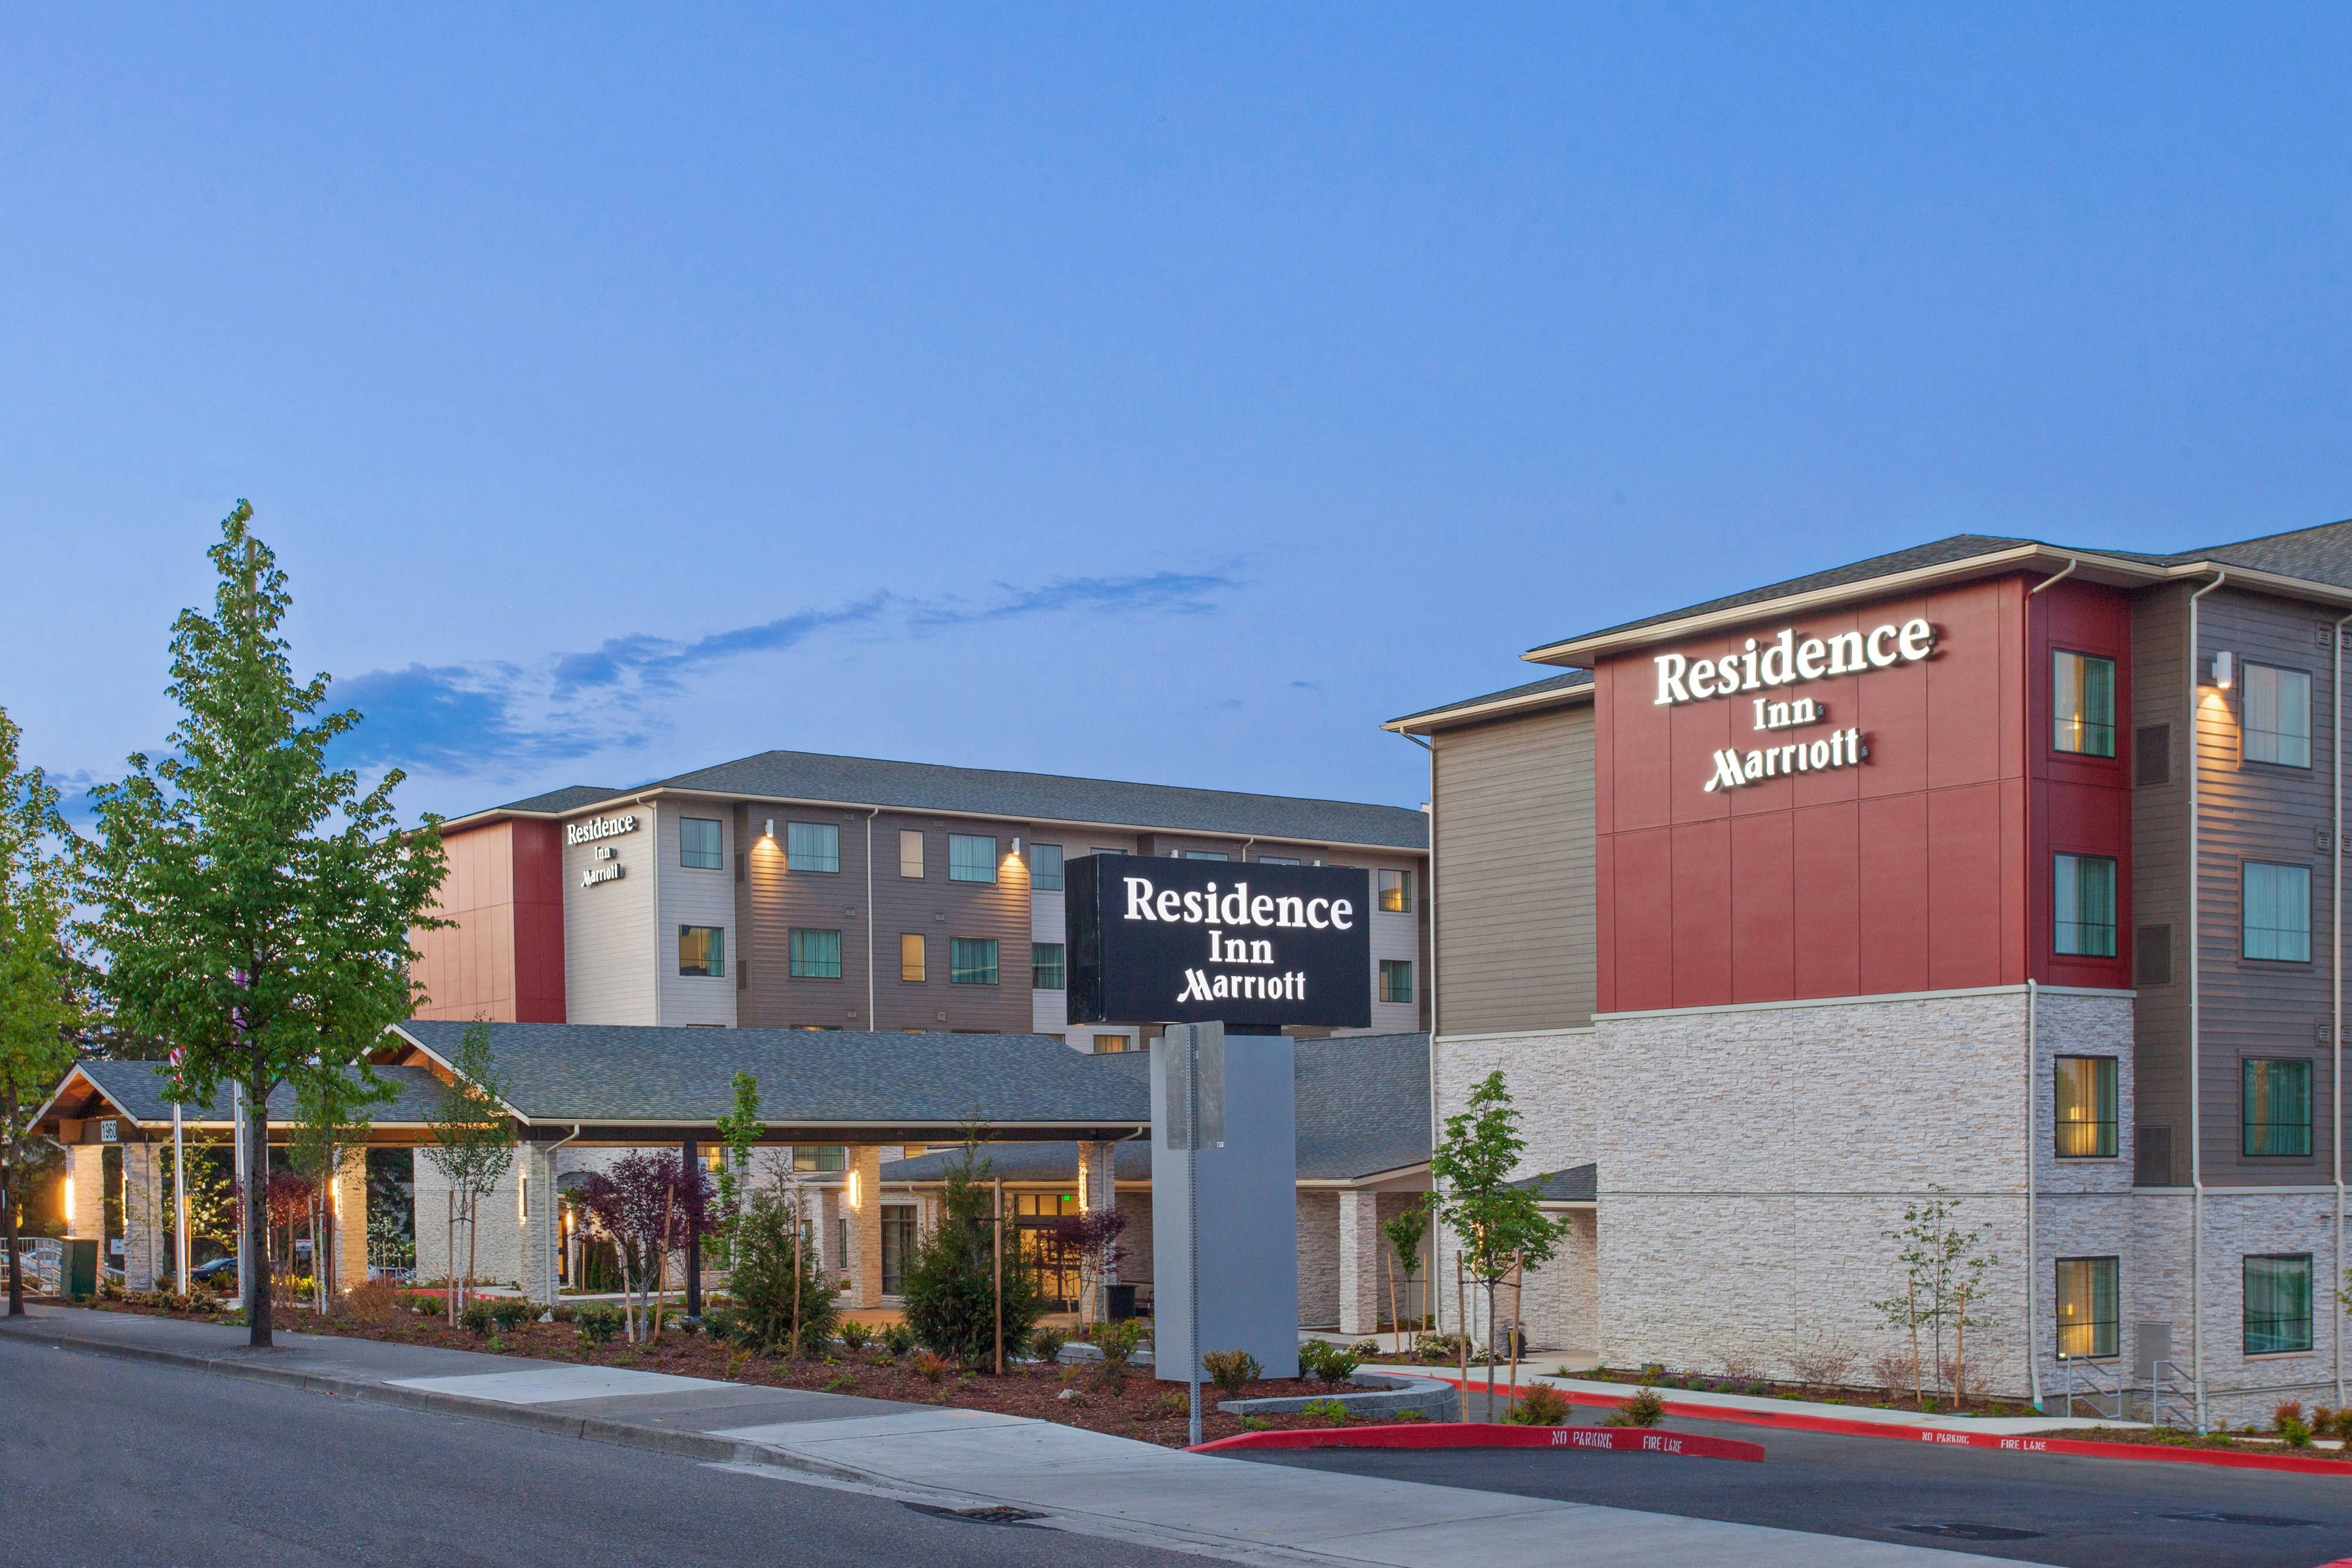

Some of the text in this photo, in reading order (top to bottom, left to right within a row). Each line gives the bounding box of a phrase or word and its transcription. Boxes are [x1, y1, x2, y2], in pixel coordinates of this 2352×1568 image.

[1653, 618, 1933, 706] Residence
[1753, 697, 1816, 731] Inn
[1703, 727, 1862, 793] Marriott
[566, 815, 635, 845] Residence
[594, 845, 612, 861] Inn
[580, 862, 620, 888] Marriott
[1122, 877, 1353, 930] Residence
[1208, 930, 1274, 964] Inn
[1176, 968, 1306, 1002] Marriott
[102, 1122, 117, 1139] 1960
[1552, 1430, 1613, 1449] NO PARKING
[1643, 1435, 1683, 1453] FIRE LANE
[1922, 1431, 1969, 1445] NO PARKING
[2000, 1439, 2047, 1451] FIRE LANE
